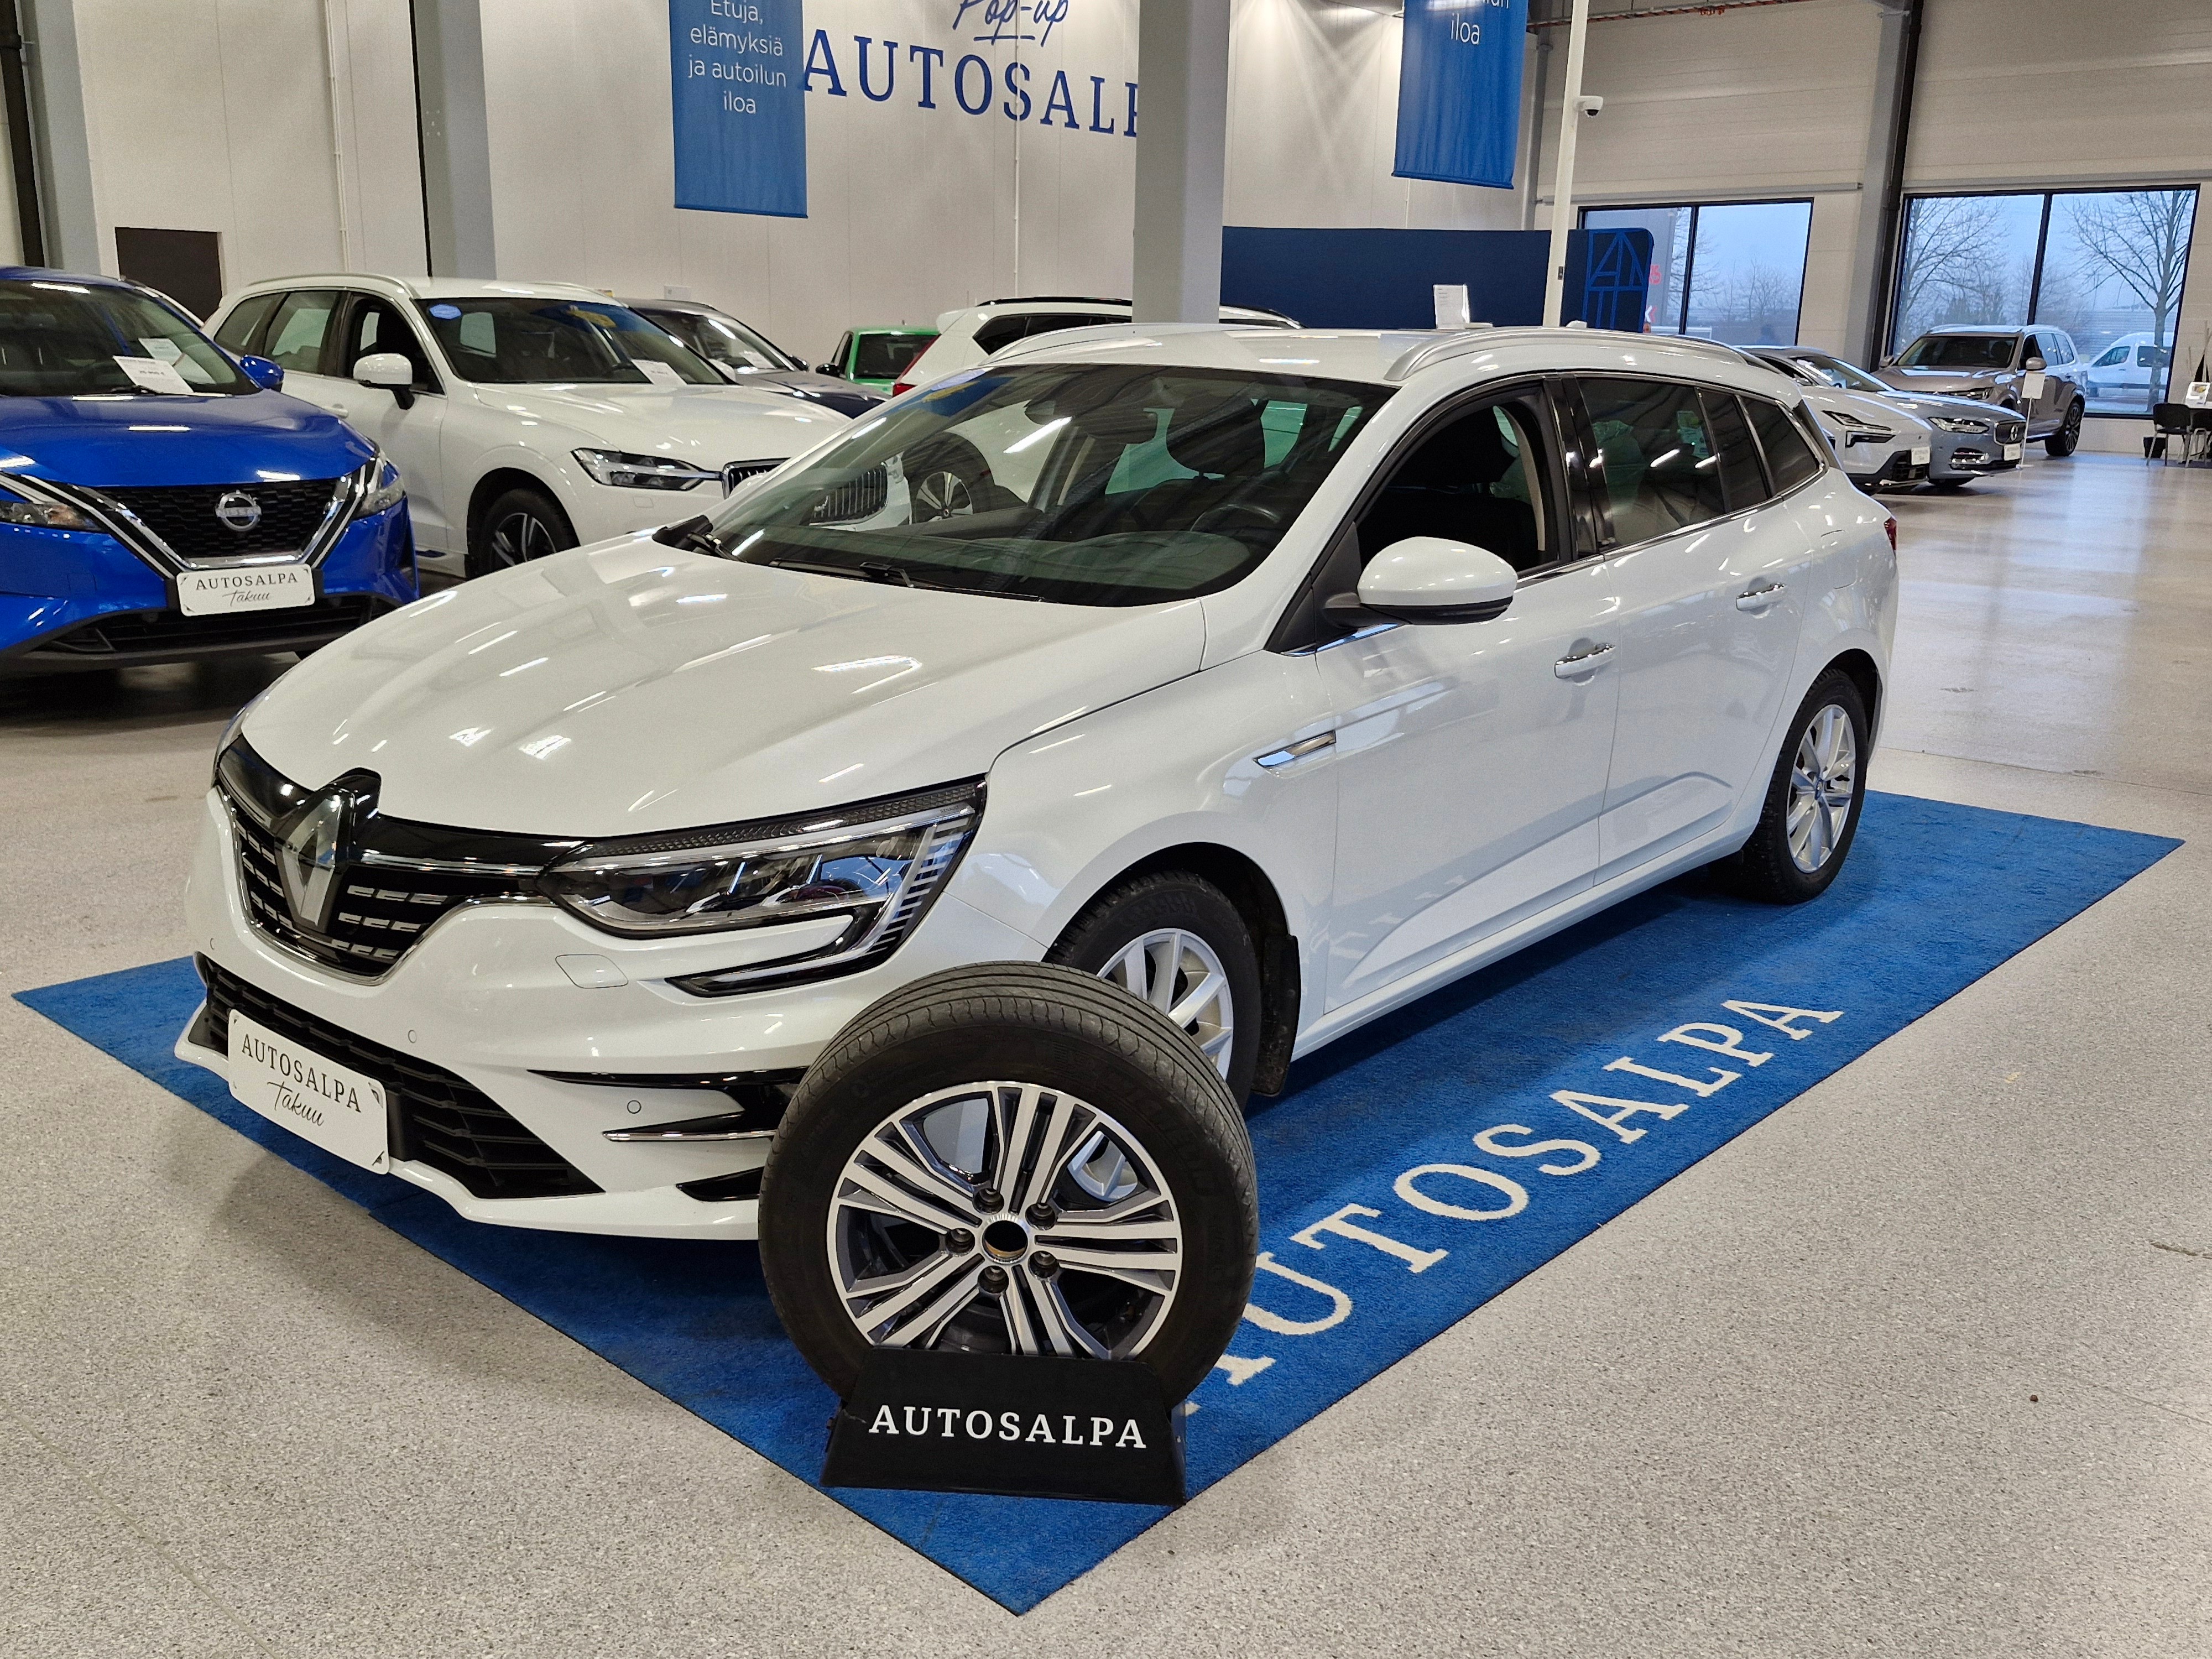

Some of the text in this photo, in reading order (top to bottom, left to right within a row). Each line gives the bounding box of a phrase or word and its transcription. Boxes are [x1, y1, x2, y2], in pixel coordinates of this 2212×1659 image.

[711, 0, 763, 25] Etuja,
[690, 24, 784, 56] elämyksiä
[1451, 13, 1480, 45] iloa
[688, 54, 787, 88] ja autoilun
[723, 90, 757, 114] iloa
[196, 572, 298, 591] AUTOSALPA
[222, 589, 271, 607] Takuu
[241, 1033, 362, 1113] AUTOSALPA
[267, 1081, 325, 1126] Takuu
[868, 1405, 1147, 1448] AUTOSALPA
